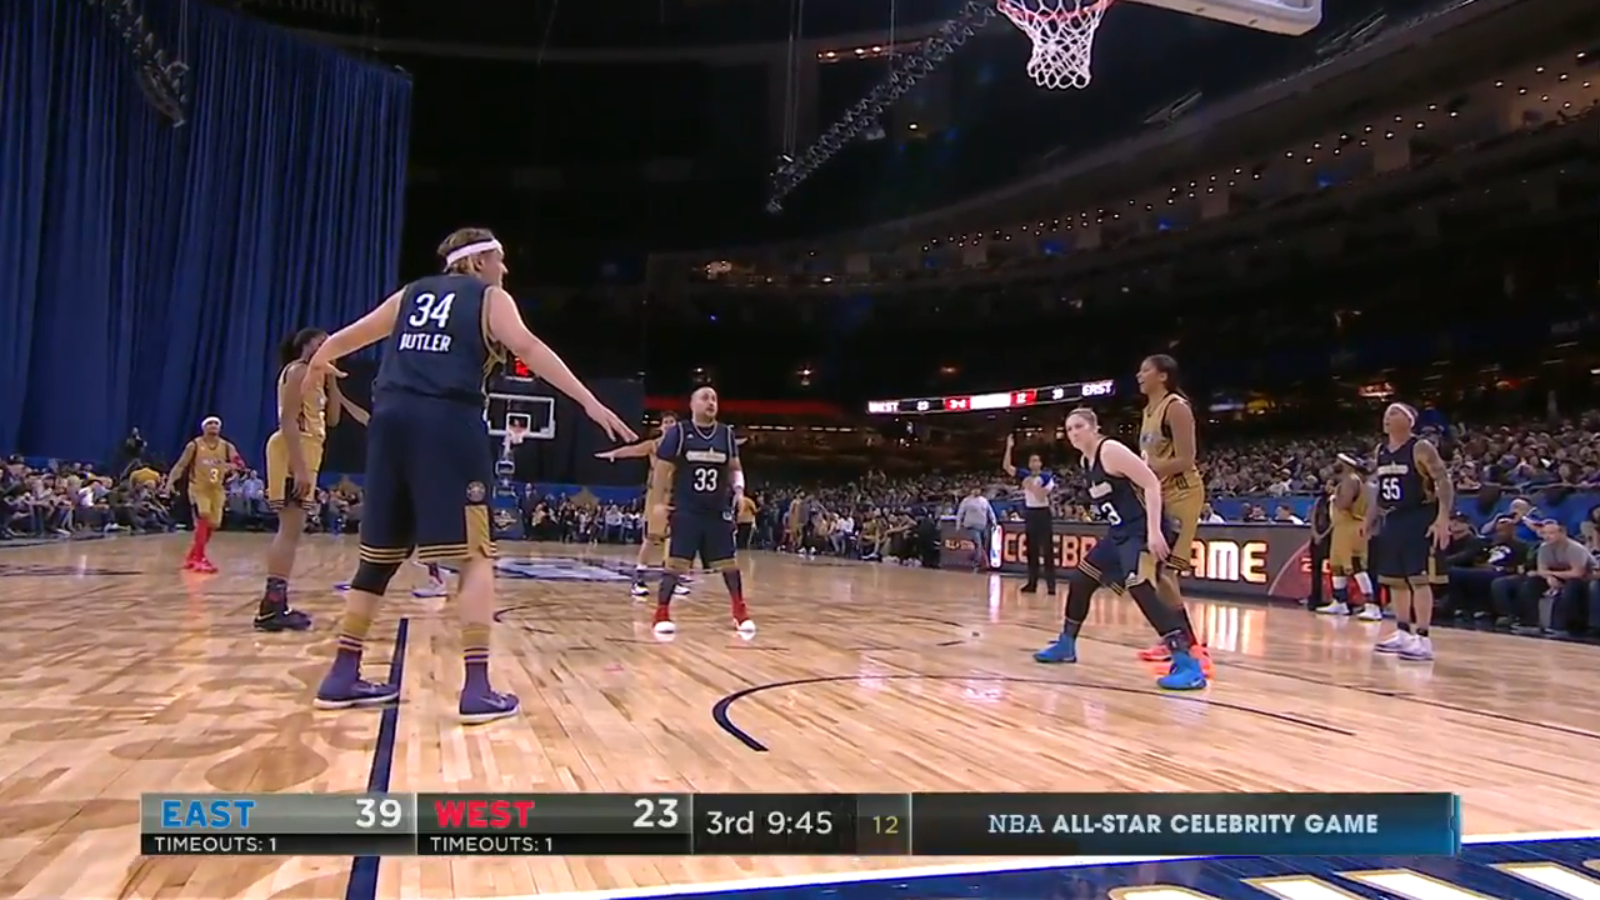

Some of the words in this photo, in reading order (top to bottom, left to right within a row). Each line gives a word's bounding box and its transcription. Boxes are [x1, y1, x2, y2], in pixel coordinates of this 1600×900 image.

[409, 293, 456, 328] 34
[1081, 381, 1113, 396] EAST
[210, 468, 219, 483] 3
[694, 468, 718, 491] 33
[1382, 477, 1401, 500] 55
